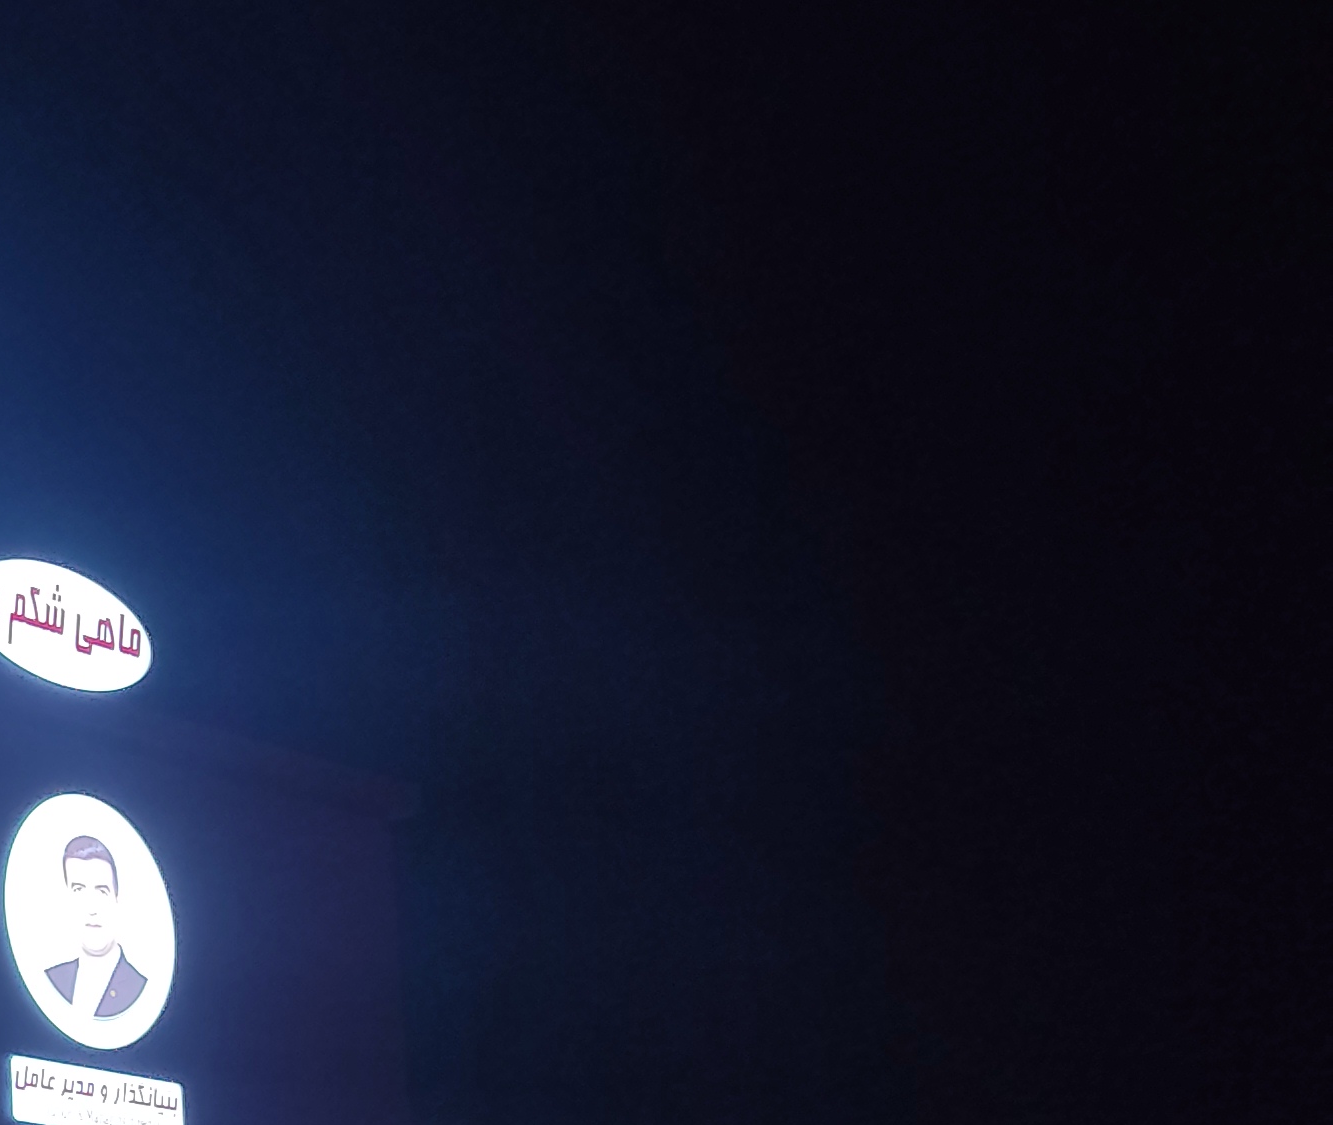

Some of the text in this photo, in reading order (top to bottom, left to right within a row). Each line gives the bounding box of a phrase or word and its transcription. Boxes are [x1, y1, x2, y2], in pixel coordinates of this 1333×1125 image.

[8, 584, 66, 644] شکم
[75, 617, 141, 658] ماهی
[15, 1066, 55, 1090] عامل
[61, 1078, 95, 1100] مدیر
[100, 1084, 108, 1103] و
